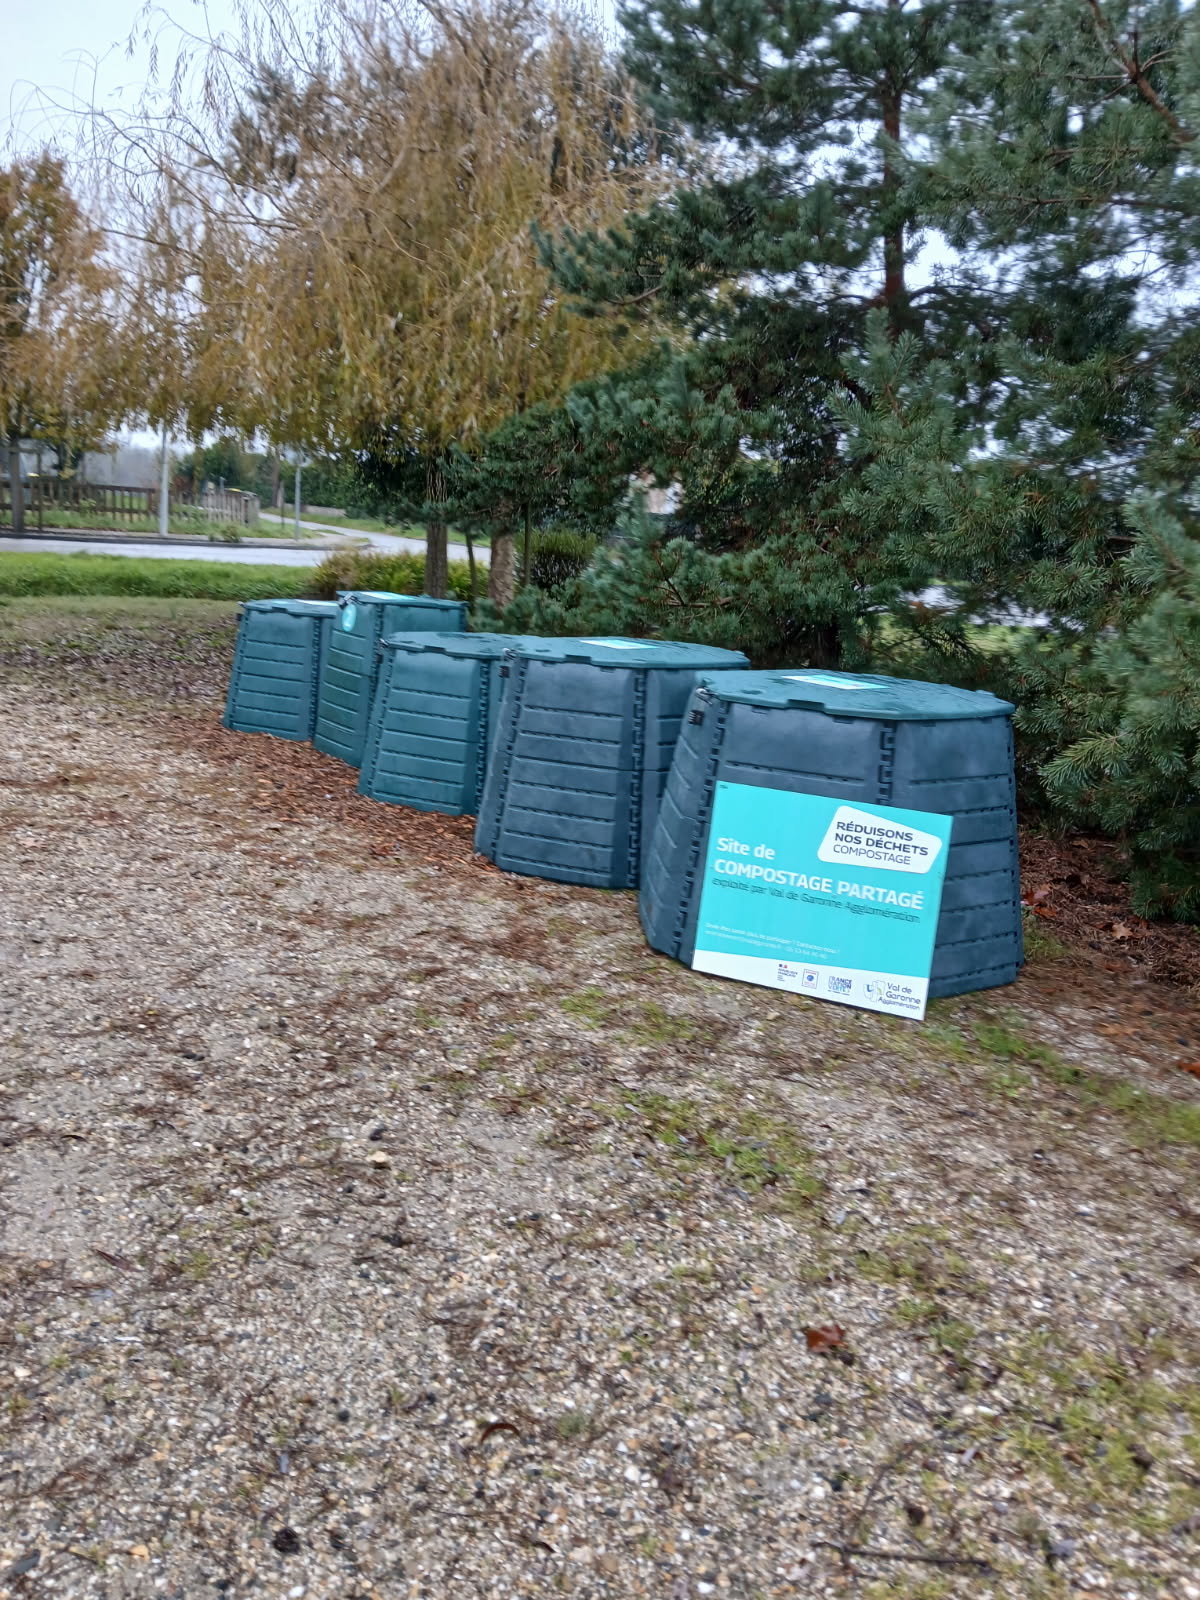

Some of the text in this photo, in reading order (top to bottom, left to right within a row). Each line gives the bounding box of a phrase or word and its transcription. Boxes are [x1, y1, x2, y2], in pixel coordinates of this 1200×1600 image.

[837, 821, 914, 842] RÉDUISONS
[716, 837, 776, 861] Site de
[833, 844, 912, 865] COMPOSTAGE
[834, 832, 929, 856] NOS DÉCHETS
[714, 859, 923, 910] COMPOSTAGE PARTAGÉ
[786, 891, 800, 901] de
[885, 991, 921, 1005] Garonne
[887, 981, 913, 995] Val de
